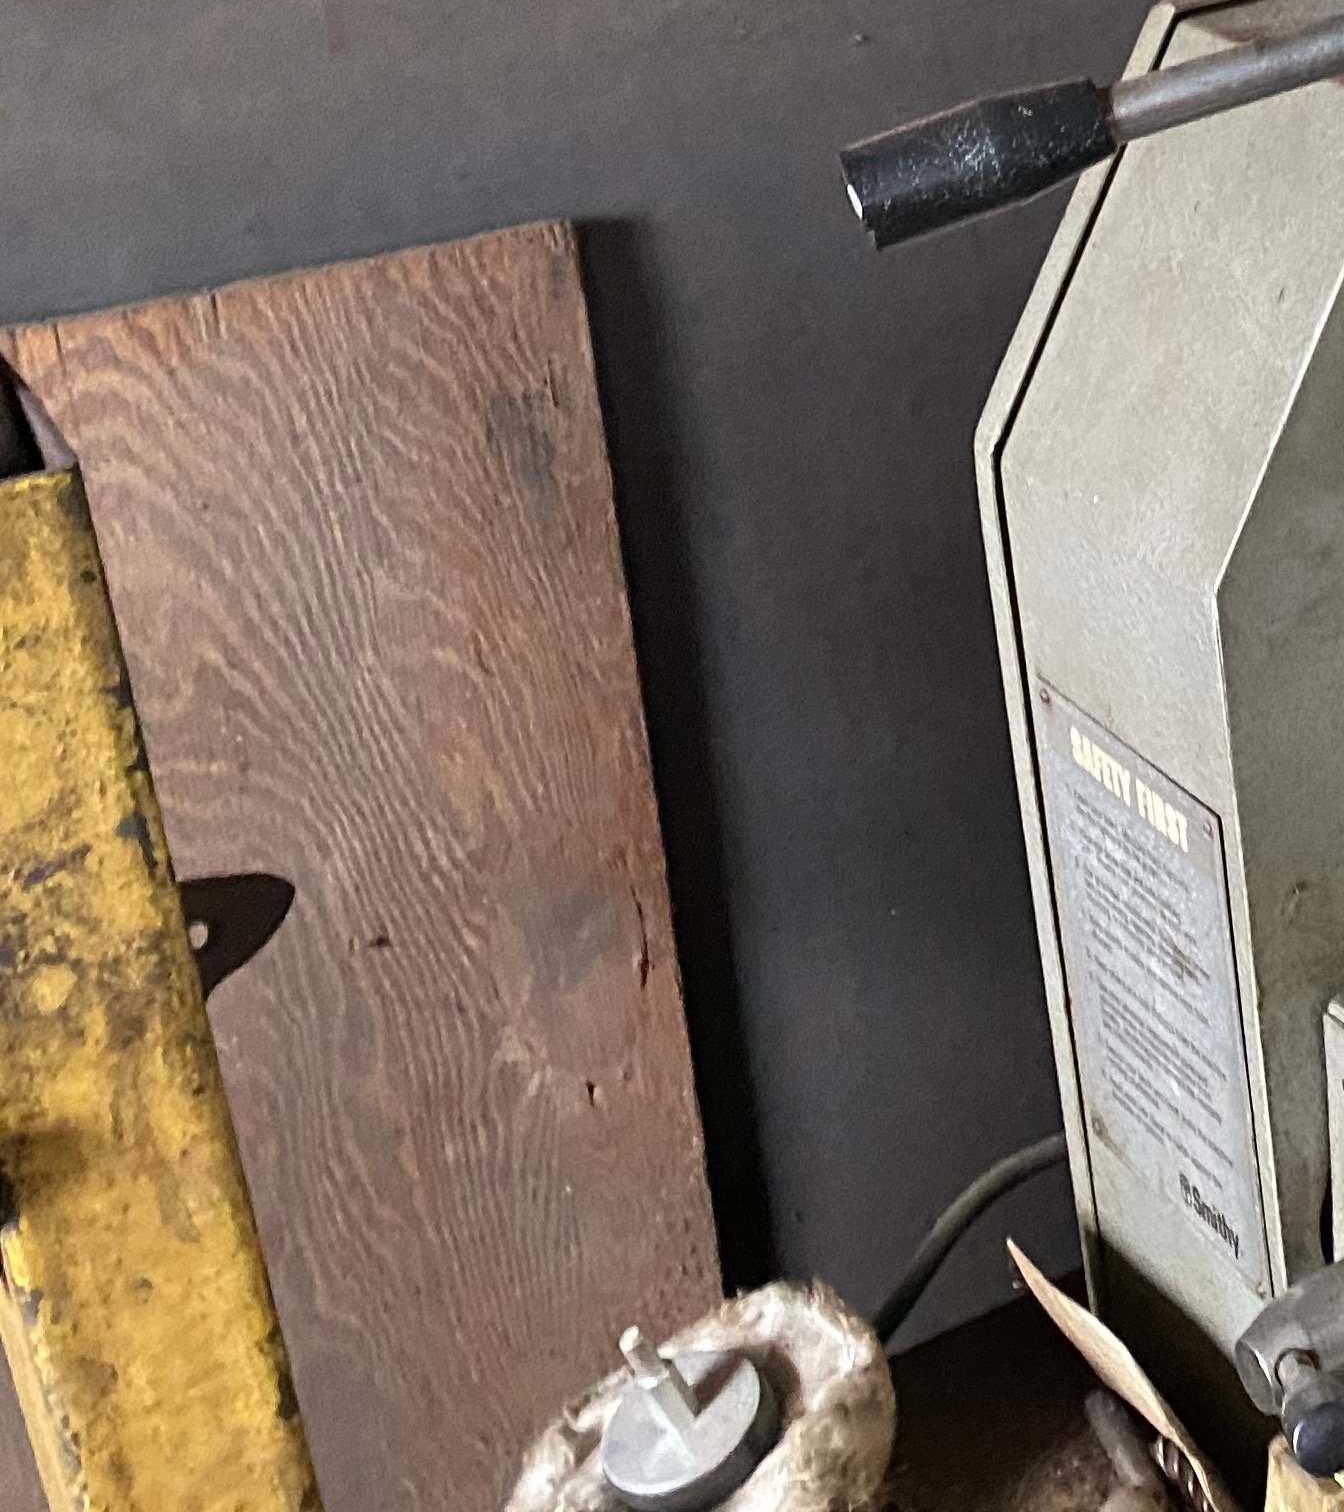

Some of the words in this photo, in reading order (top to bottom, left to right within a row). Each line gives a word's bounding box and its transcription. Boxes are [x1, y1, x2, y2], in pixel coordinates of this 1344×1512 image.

[1069, 724, 1132, 807] SAFETY
[1134, 775, 1189, 854] FIRST
[1192, 1184, 1240, 1260] Smithy
